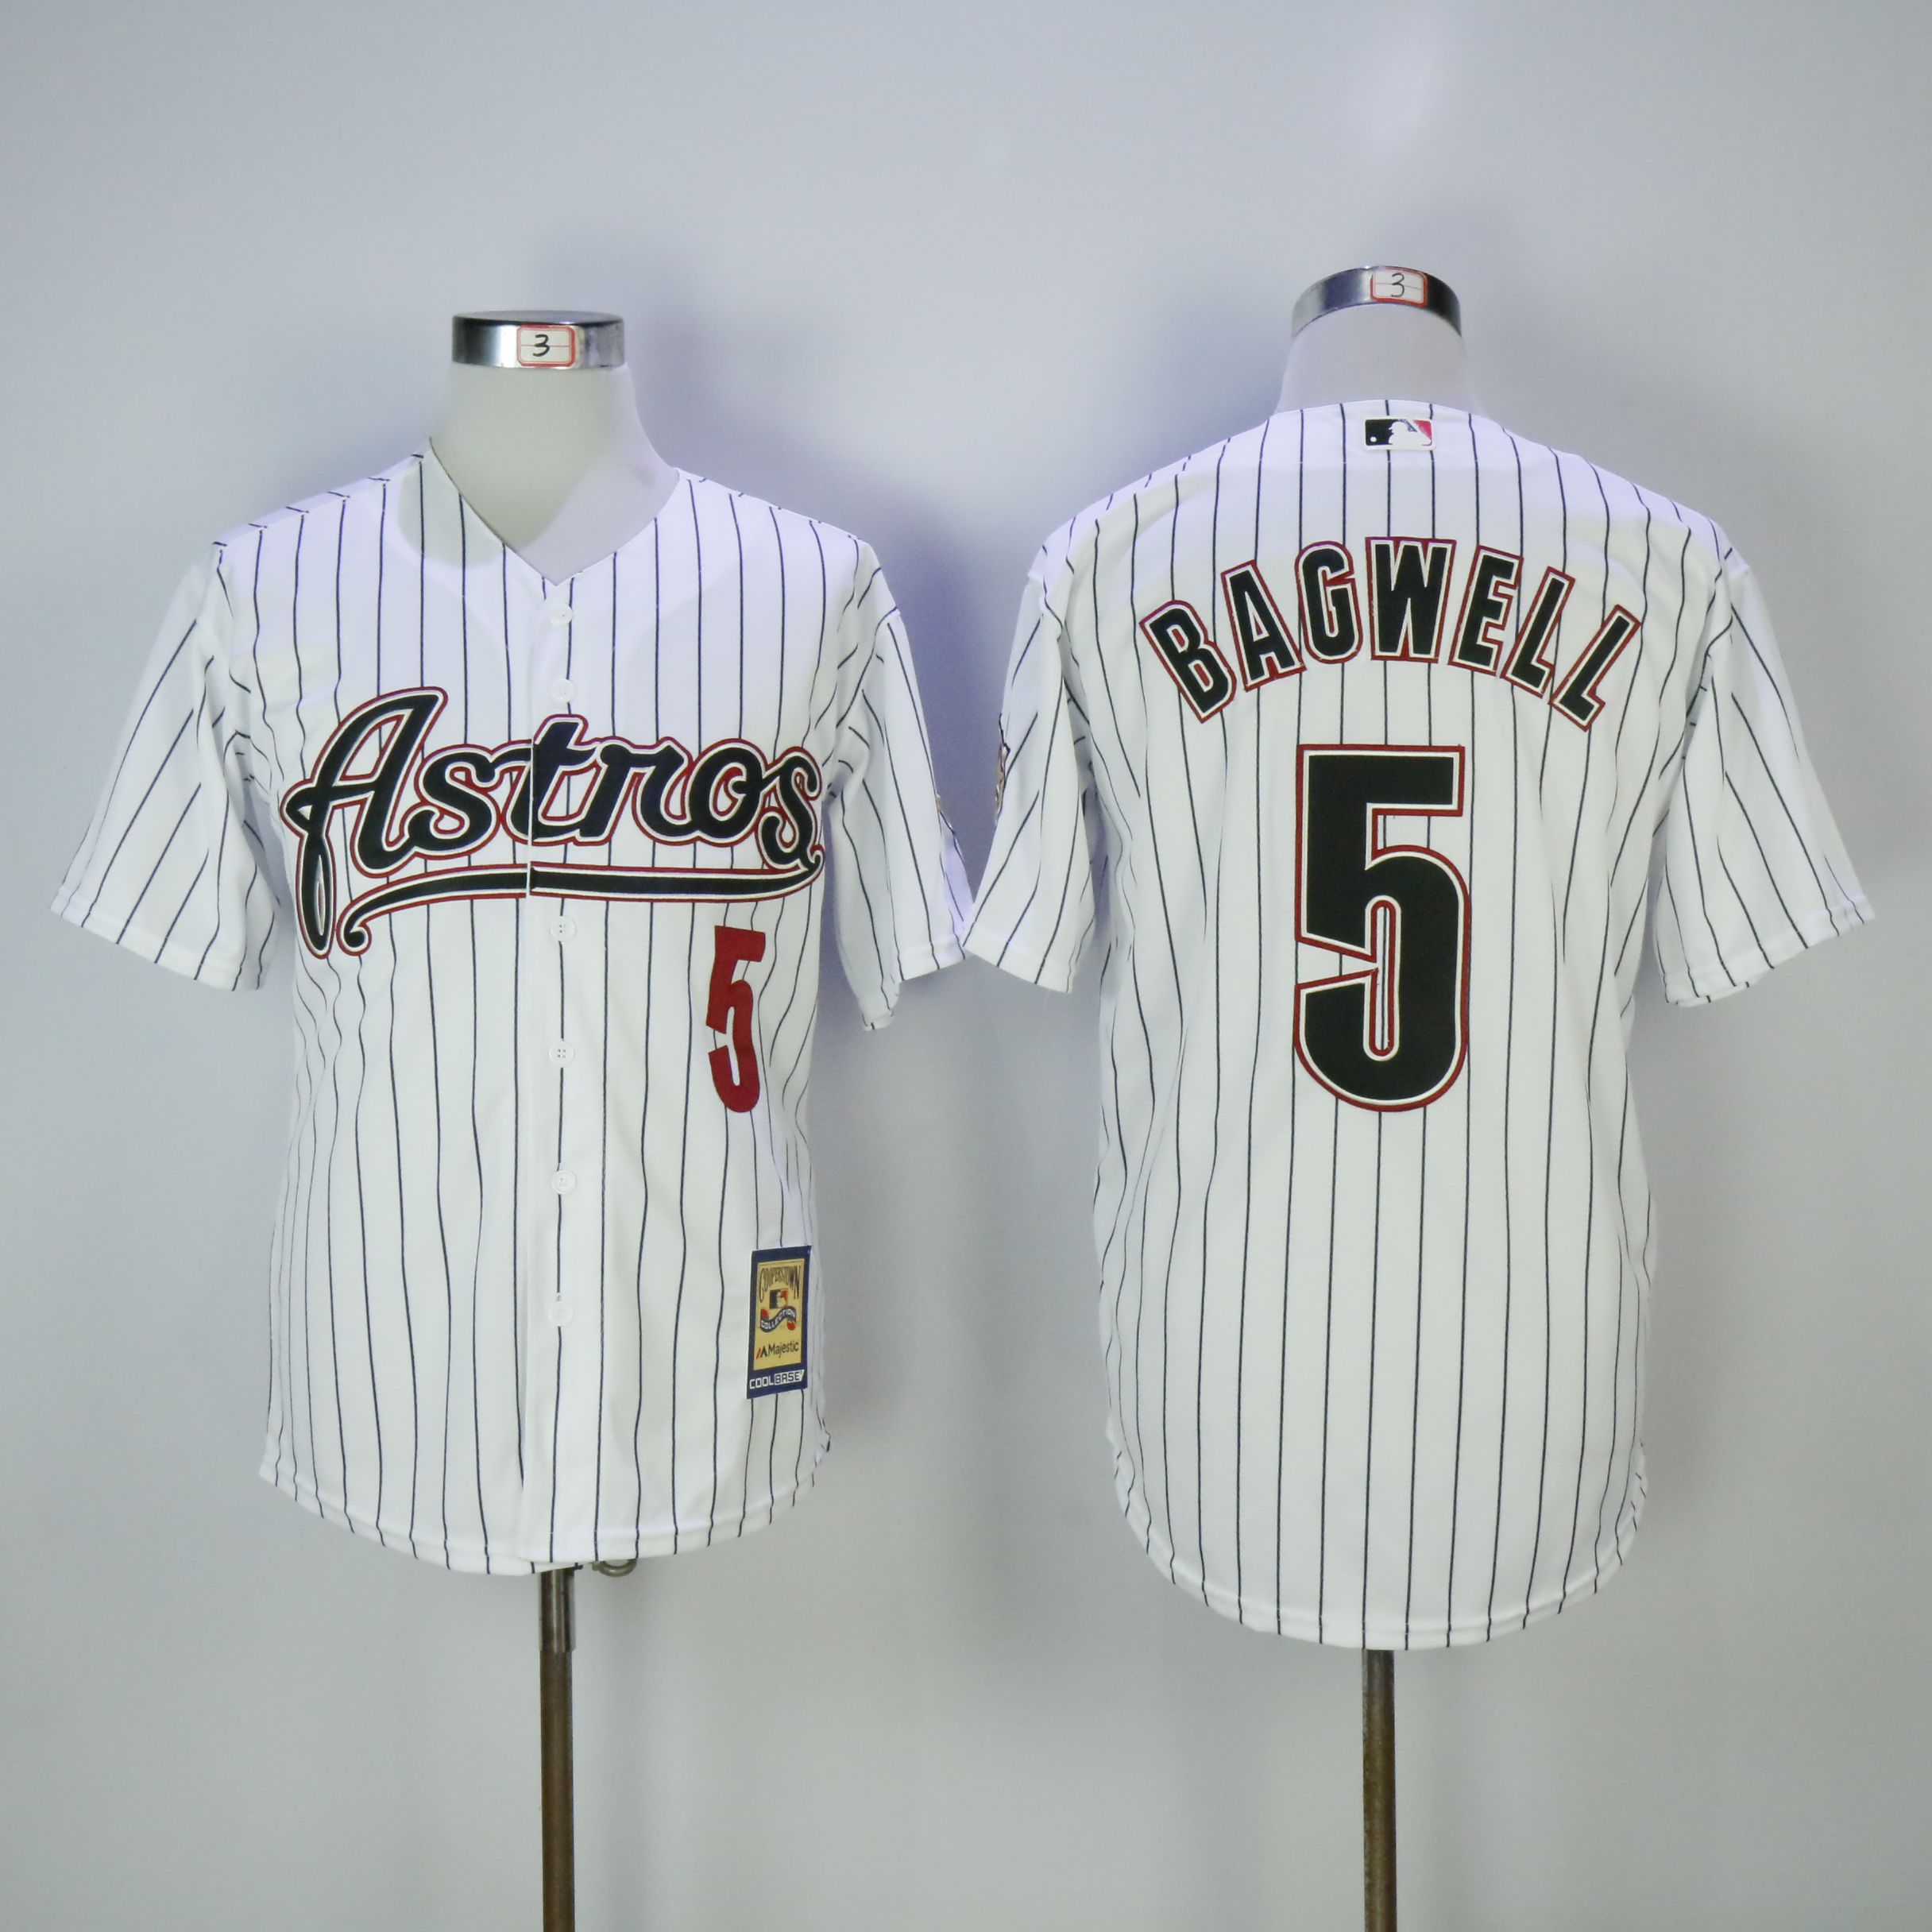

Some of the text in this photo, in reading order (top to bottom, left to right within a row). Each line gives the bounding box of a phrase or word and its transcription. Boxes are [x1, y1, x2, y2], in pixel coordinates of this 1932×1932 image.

[1391, 272, 1405, 298] 3
[532, 334, 551, 357] 3
[1139, 536, 1642, 732] BAGWELL
[280, 686, 825, 960] Astros
[1294, 744, 1471, 1112] 5
[706, 925, 766, 1113] 5
[760, 1308, 797, 1331] COLLECTION
[768, 1340, 799, 1358] Majestic
